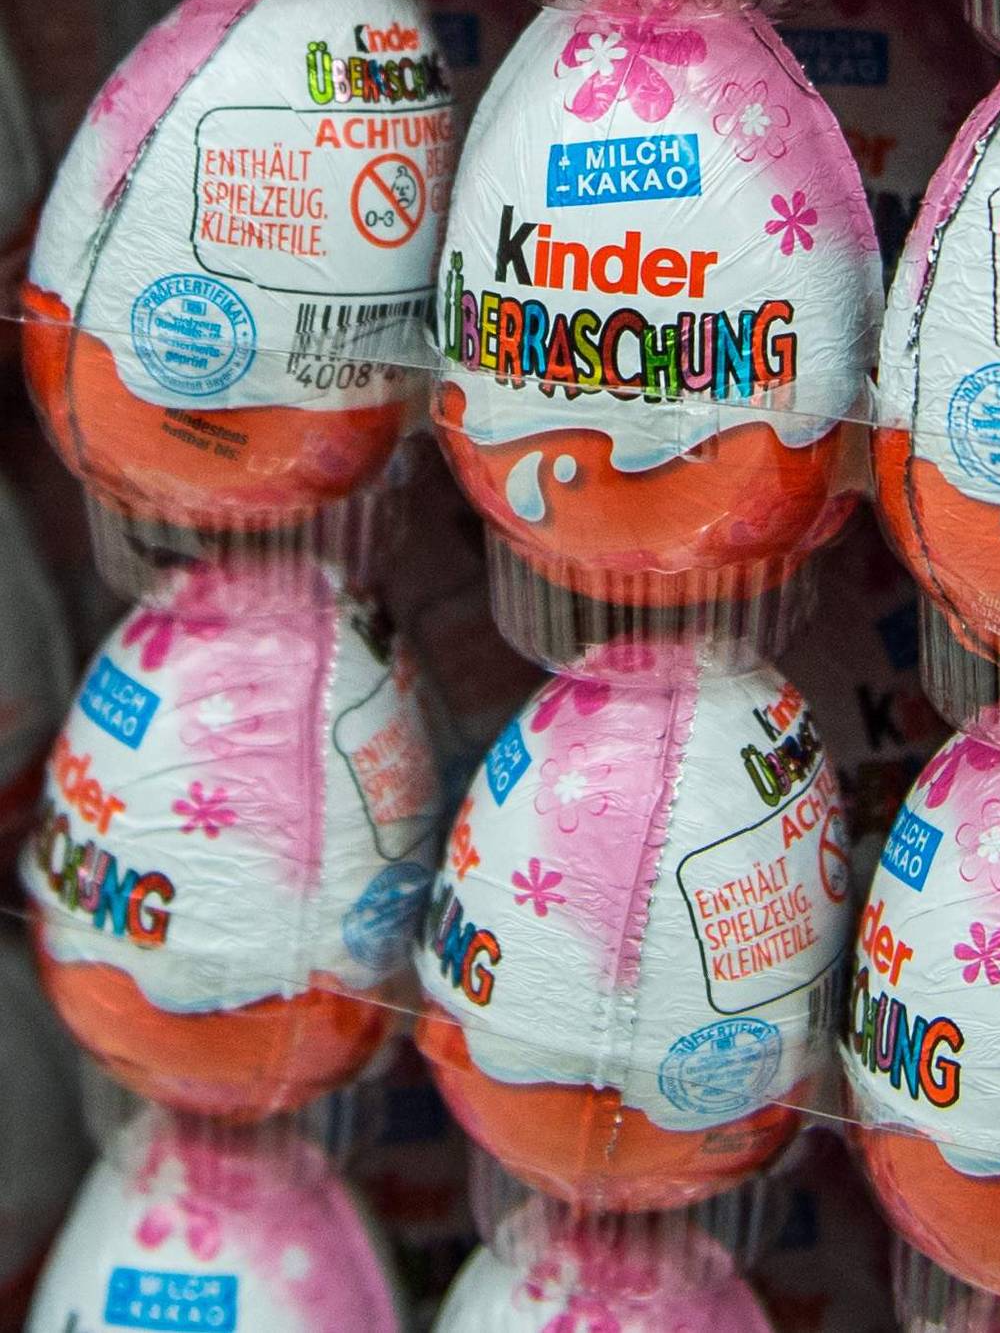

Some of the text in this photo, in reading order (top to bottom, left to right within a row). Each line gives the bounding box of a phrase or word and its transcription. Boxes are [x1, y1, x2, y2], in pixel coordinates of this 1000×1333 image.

[204, 144, 313, 181] ENTHÄLT
[585, 142, 680, 169] MILCH
[578, 166, 689, 196] KAKAO
[203, 182, 328, 219] SPIELZEUG.
[365, 210, 395, 228] 0-3
[201, 214, 328, 256] KLEINTEILE.
[495, 205, 718, 299] Kinder
[444, 250, 798, 404] ÜBERRASCHUNG
[296, 364, 373, 390] 4008
[704, 883, 812, 951] SPIELZEUG.
